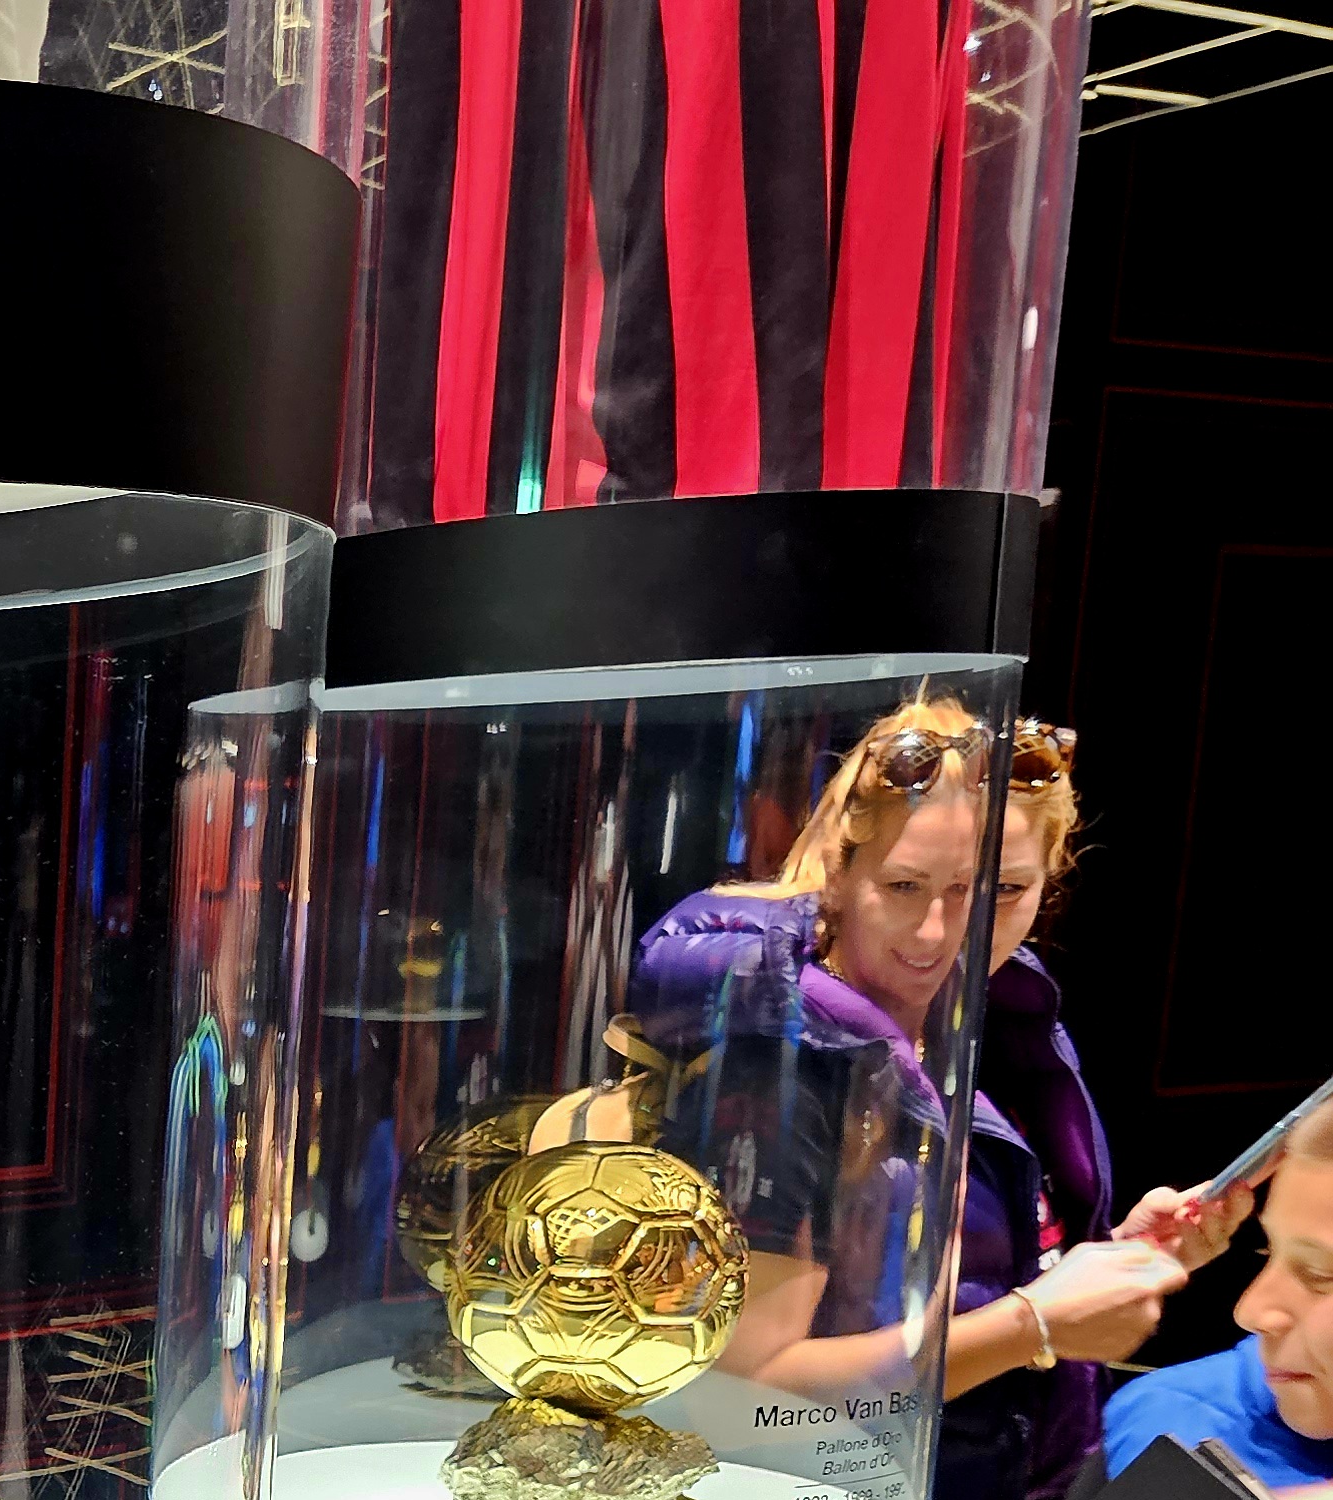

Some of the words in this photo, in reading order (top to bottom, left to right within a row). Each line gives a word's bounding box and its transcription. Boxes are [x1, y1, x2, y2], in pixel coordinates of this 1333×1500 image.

[754, 1405, 837, 1428] Marco
[845, 1398, 884, 1420] Van
[889, 1391, 918, 1414] Bas
[816, 1438, 869, 1456] Pallone
[872, 1431, 903, 1448] d'Oro
[822, 1459, 867, 1476] Ballon
